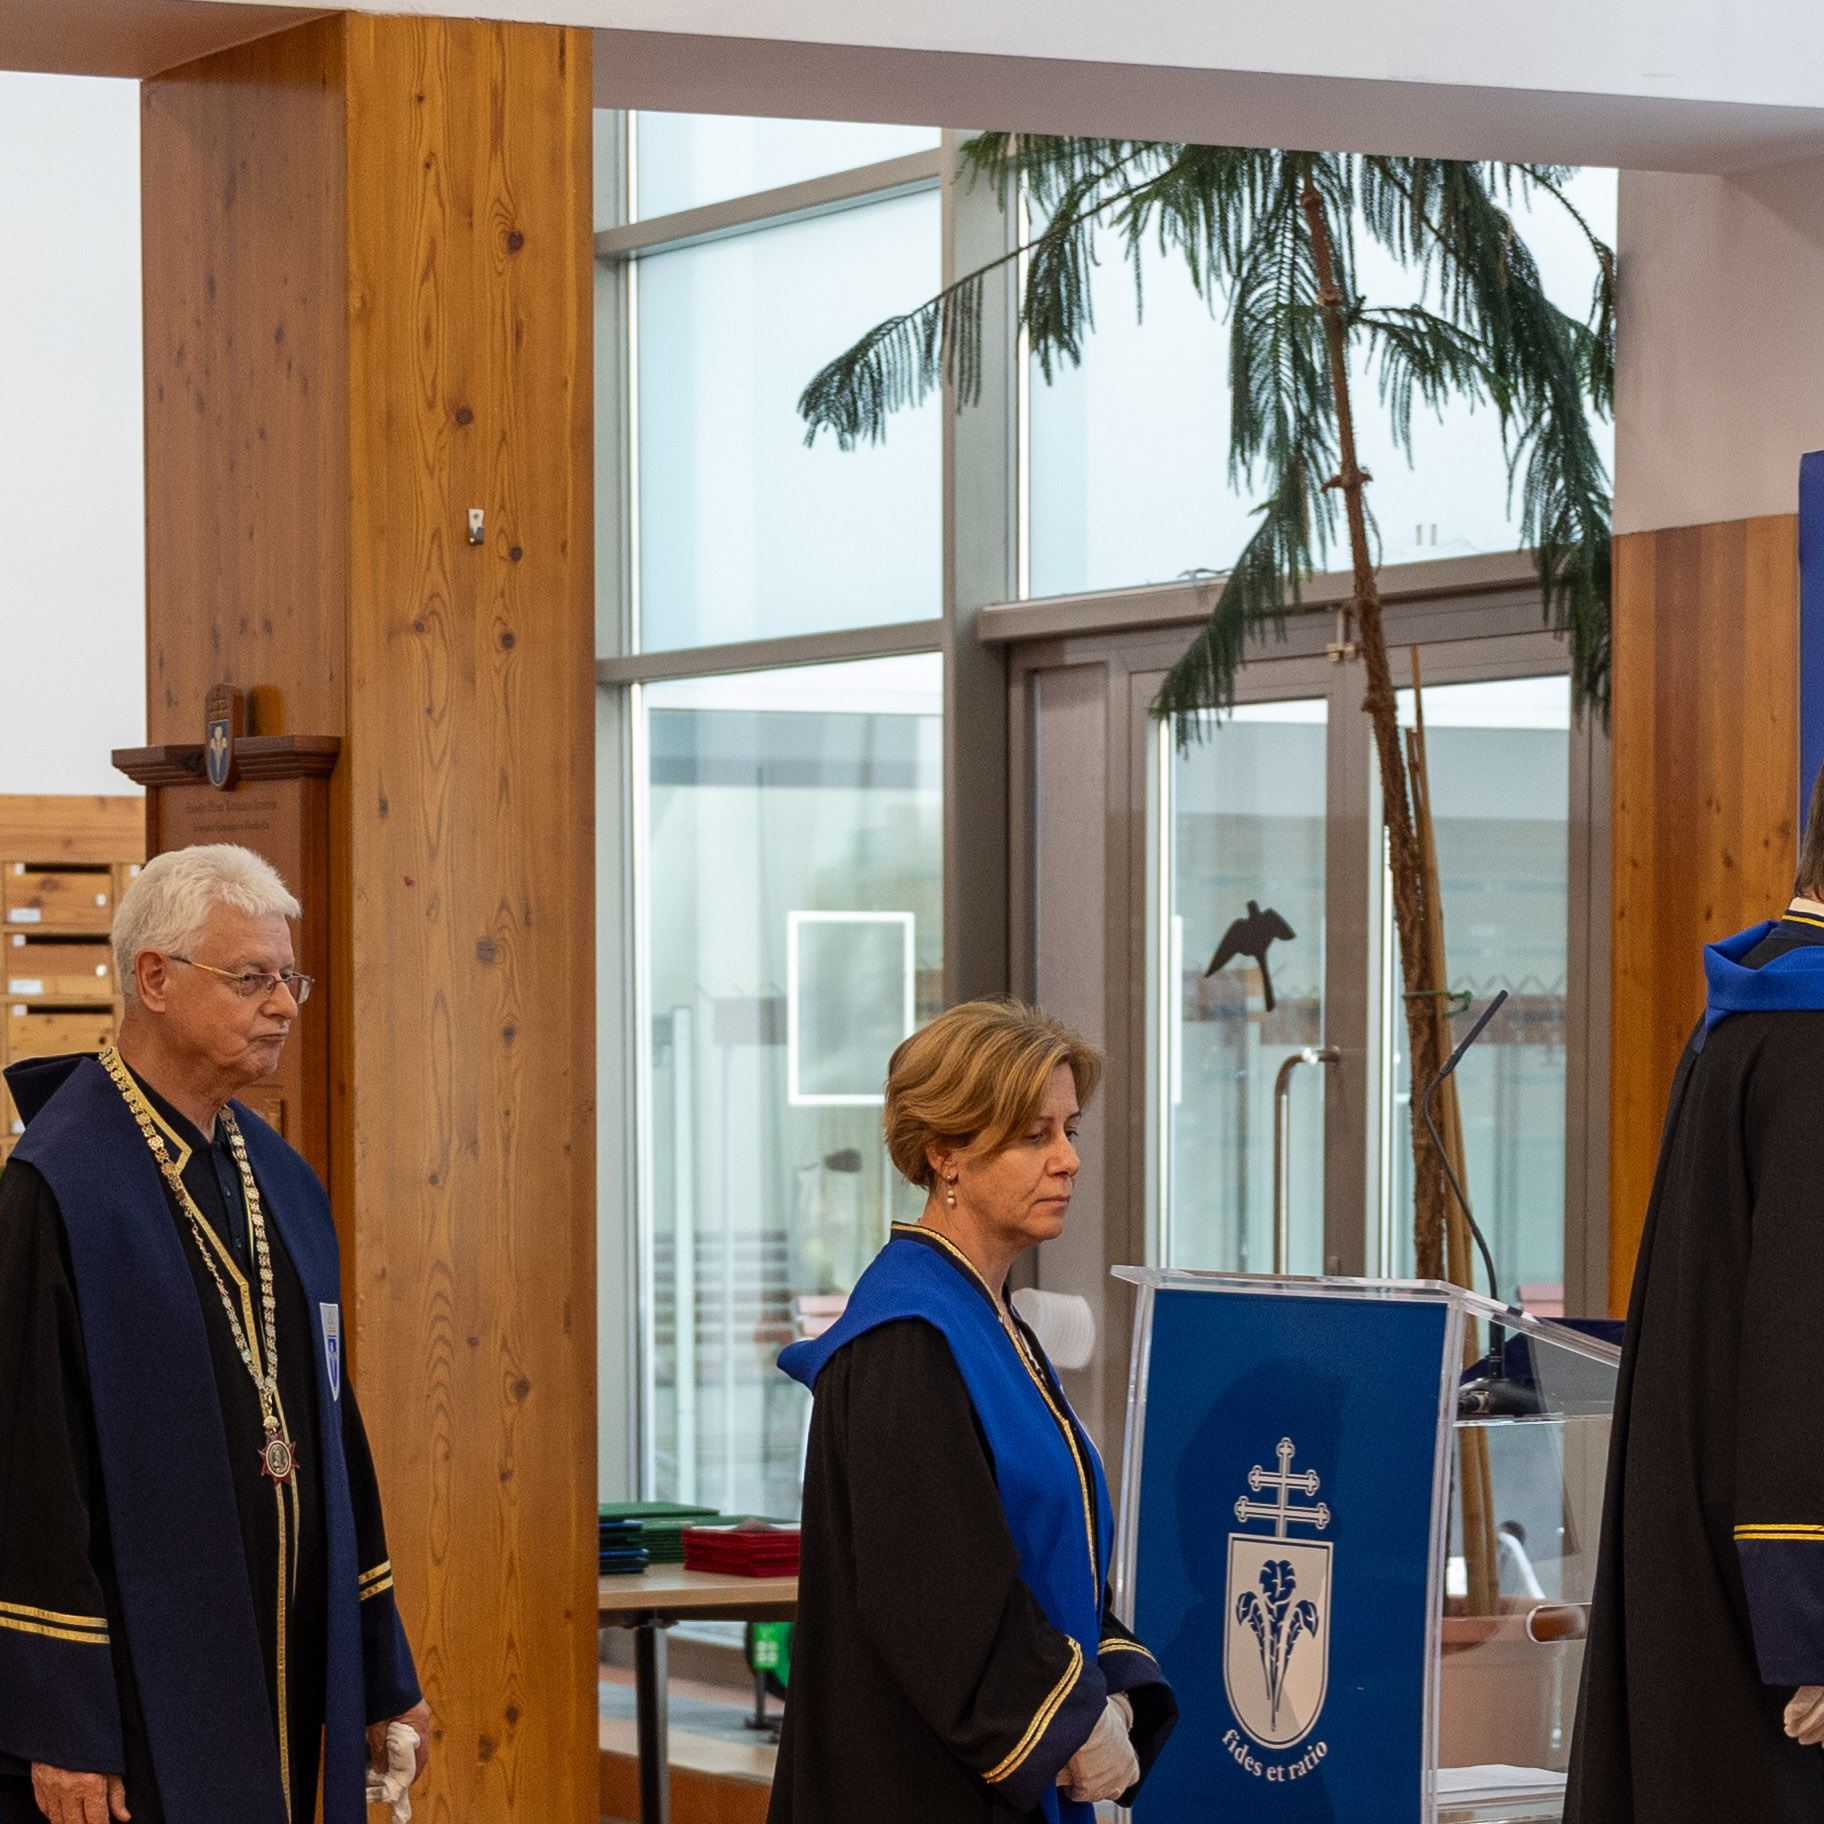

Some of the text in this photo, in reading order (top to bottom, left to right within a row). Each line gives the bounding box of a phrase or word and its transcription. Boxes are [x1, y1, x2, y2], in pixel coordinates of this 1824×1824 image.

[1222, 1729, 1328, 1782] fides et ratio
